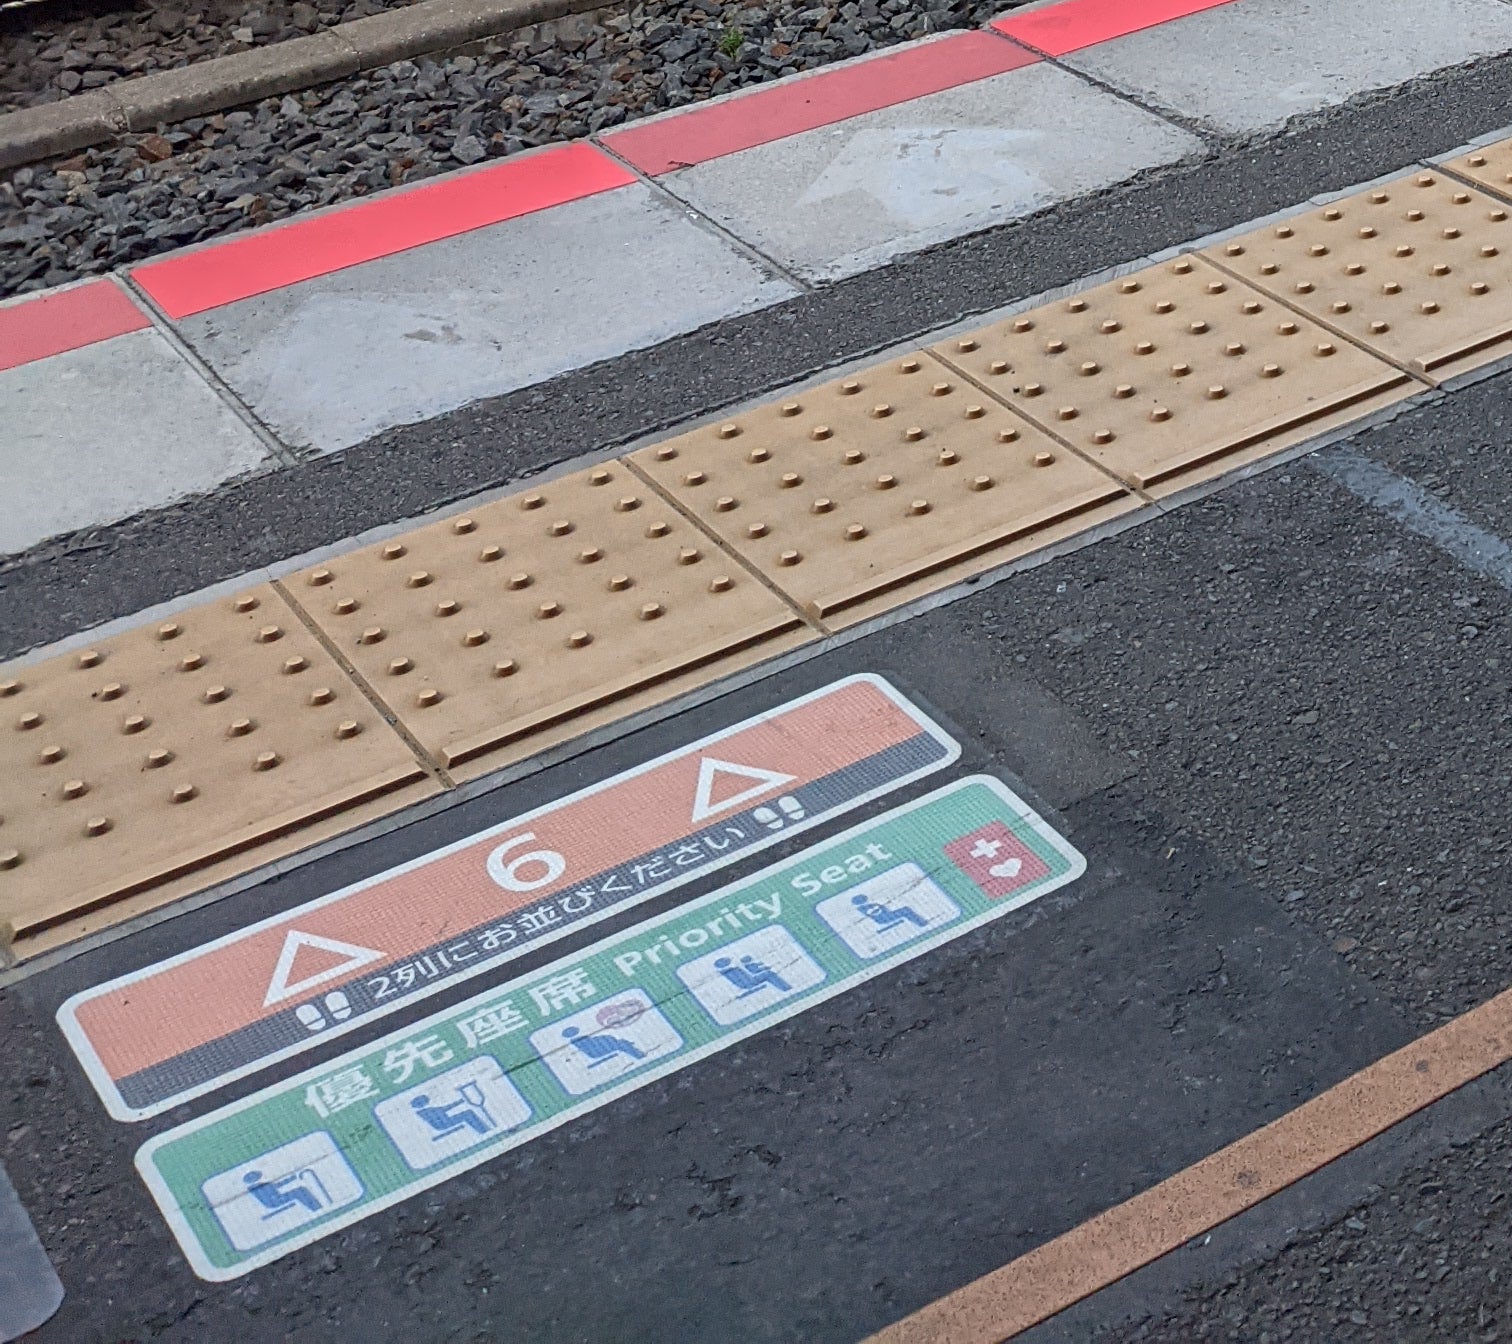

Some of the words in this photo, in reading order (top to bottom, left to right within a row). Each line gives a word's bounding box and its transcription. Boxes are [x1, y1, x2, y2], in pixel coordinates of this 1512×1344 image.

[367, 826, 748, 1000] 2列にお並びください
[485, 831, 566, 893] 6
[303, 966, 597, 1118] 優先座席
[613, 892, 783, 977] Priority
[790, 841, 893, 898] Seat
